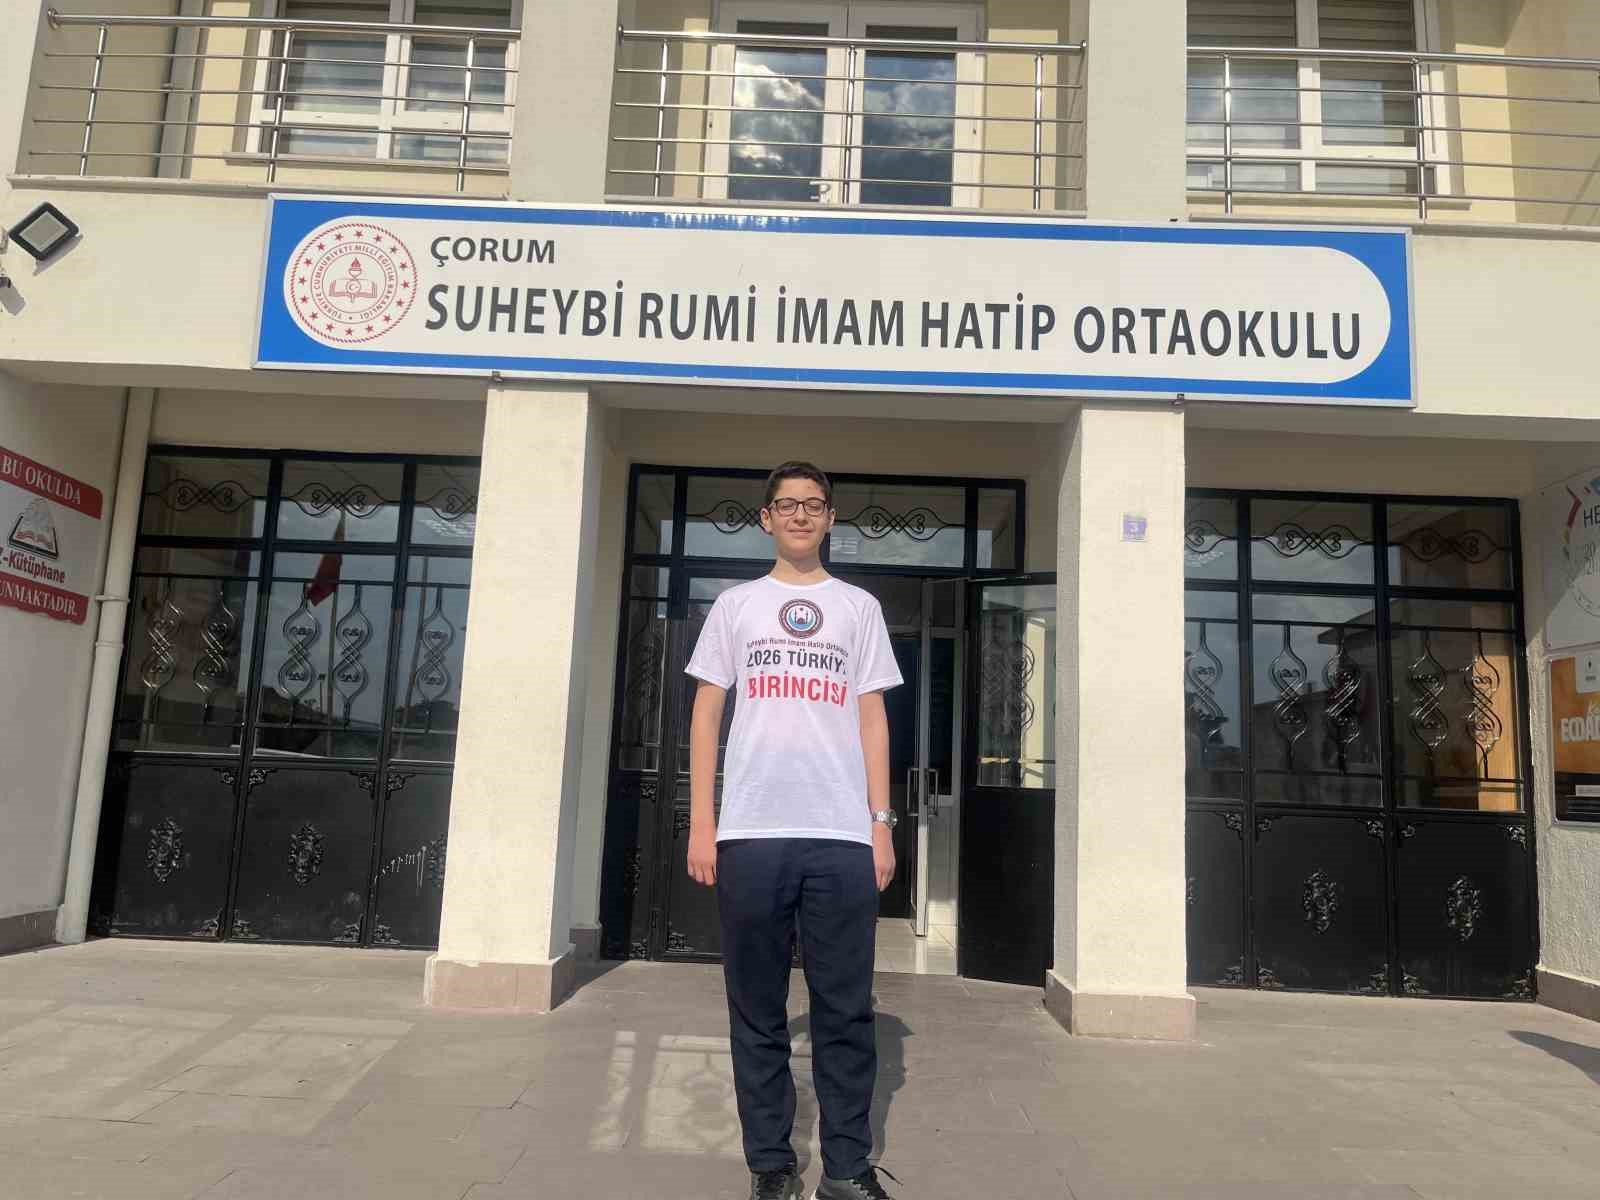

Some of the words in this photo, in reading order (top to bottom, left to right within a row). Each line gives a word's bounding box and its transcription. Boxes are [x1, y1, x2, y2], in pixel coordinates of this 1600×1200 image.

[431, 237, 554, 267] ÇORUM
[426, 280, 623, 337] SUHEYBİ
[639, 285, 755, 342] RUMİ
[777, 286, 903, 346] İMAM
[921, 293, 1055, 350] HATİP
[1074, 307, 1359, 359] ORTAOKULU
[2, 455, 23, 479] BU
[25, 466, 81, 505] OKULDA
[746, 649, 781, 668] 2026
[787, 648, 846, 675] TÜRKİY
[748, 671, 848, 707] BİRİNCİSİ
